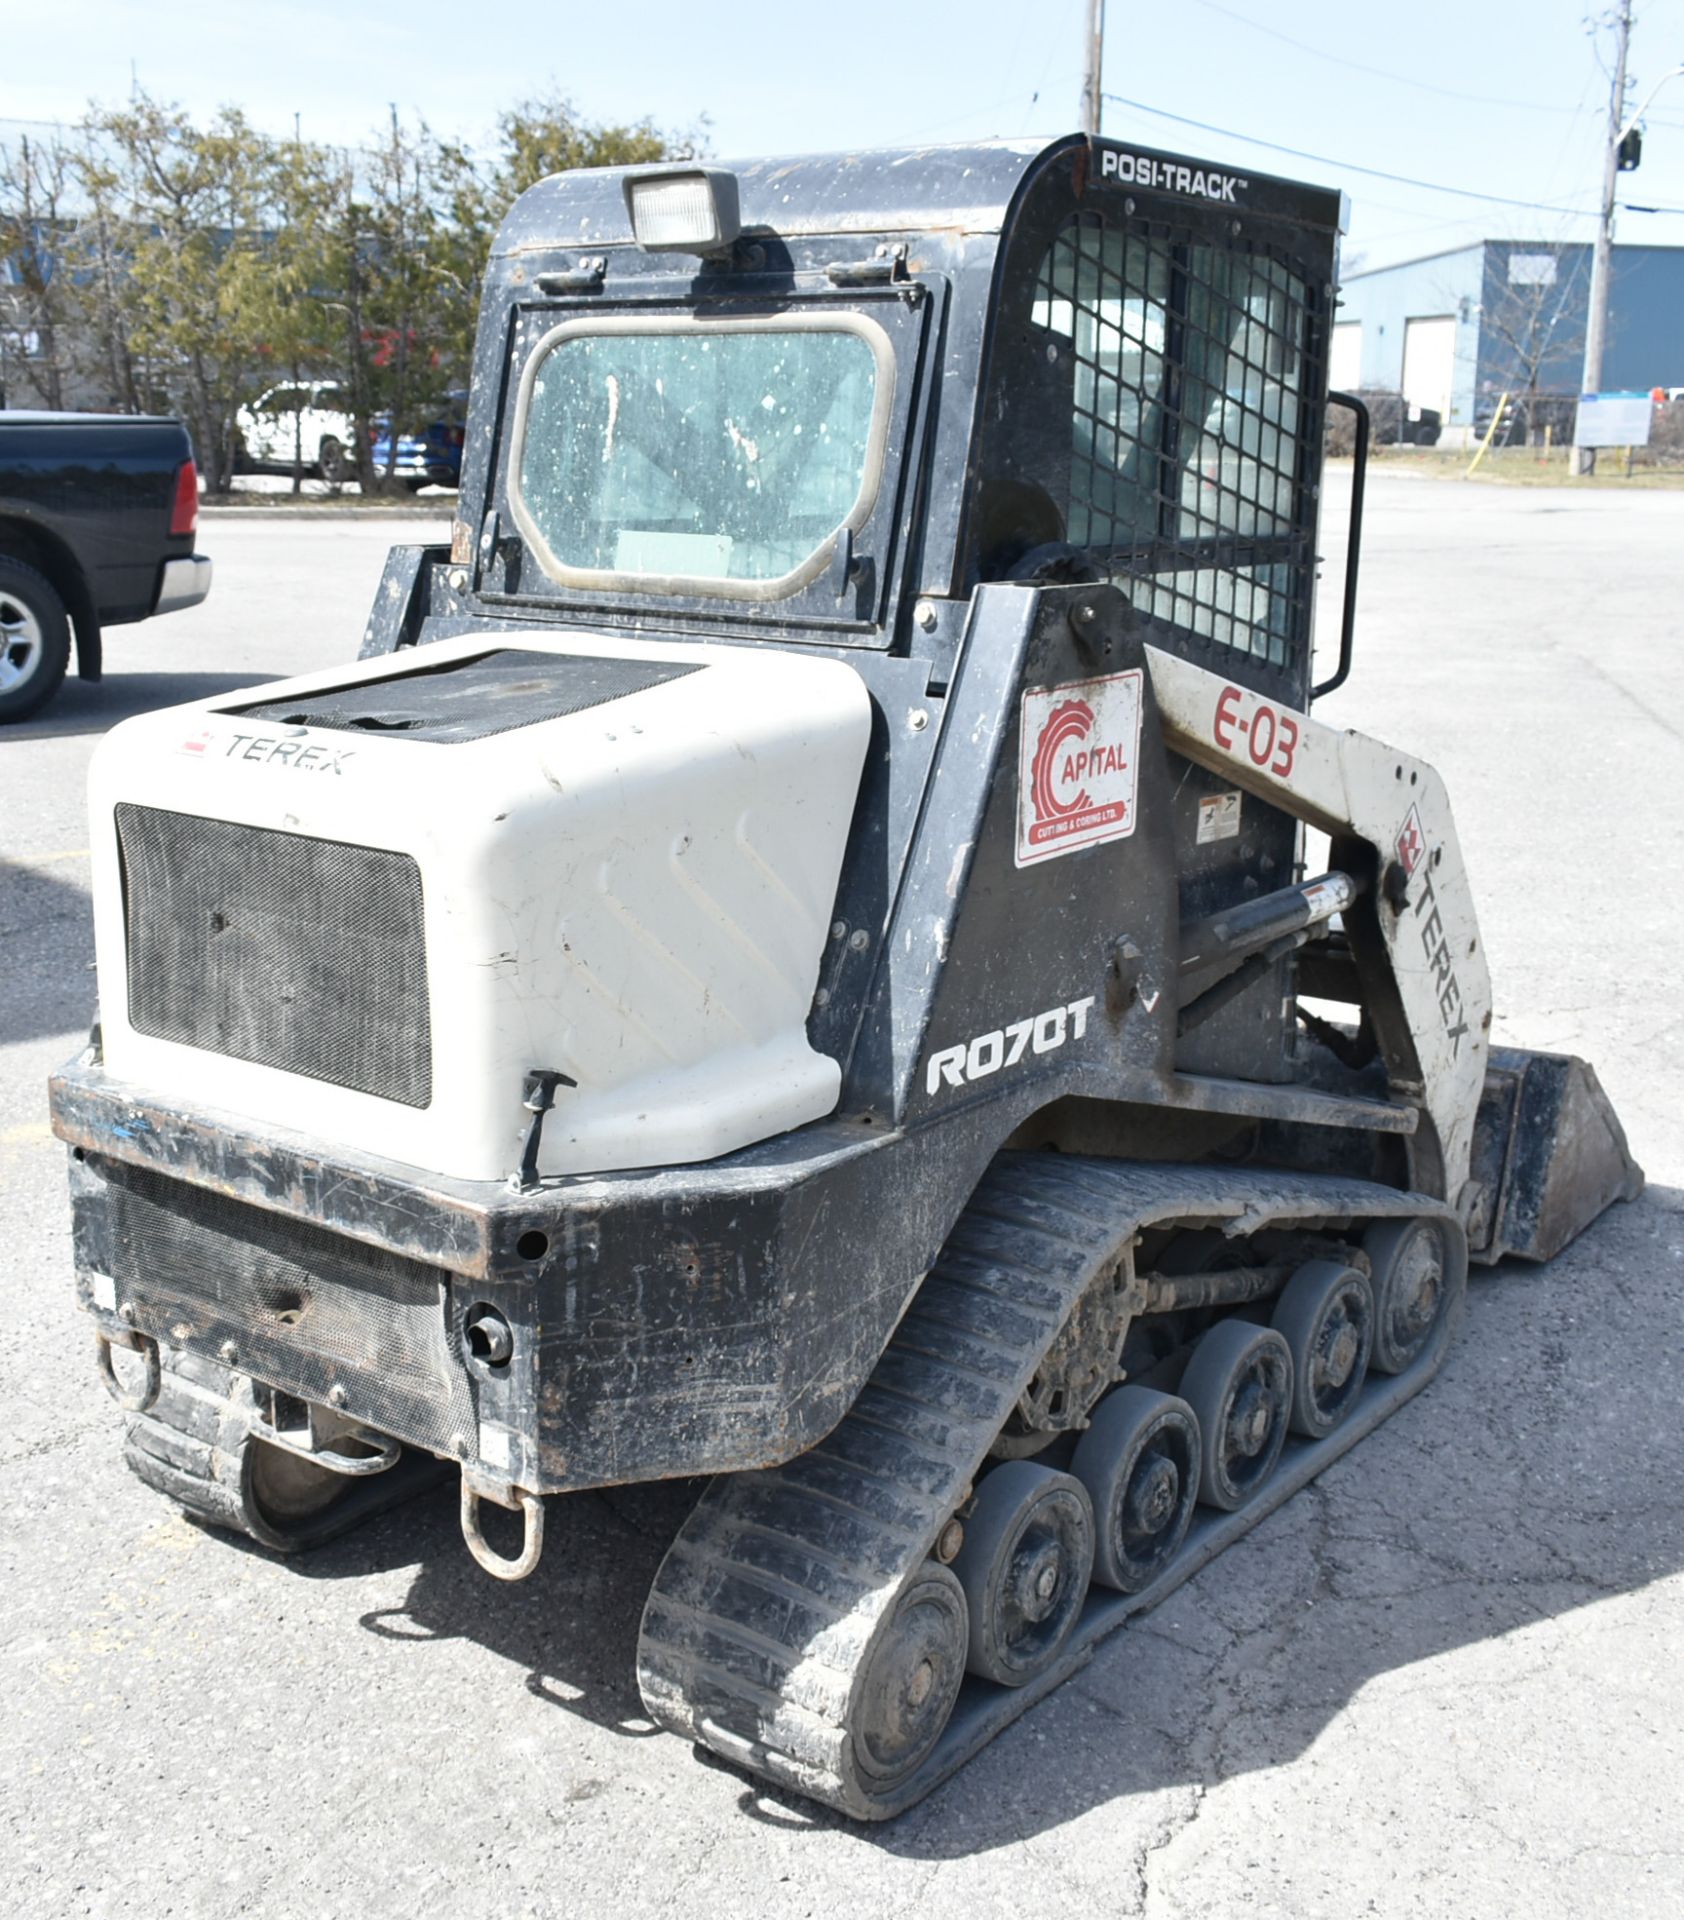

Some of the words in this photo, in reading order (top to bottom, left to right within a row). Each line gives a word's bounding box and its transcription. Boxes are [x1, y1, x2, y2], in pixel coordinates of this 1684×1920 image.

[226, 734, 356, 775] TEREX
[1214, 686, 1298, 778] E-03
[1037, 821, 1068, 839] CUTTING
[1069, 819, 1075, 831] &
[1076, 812, 1102, 827] CORING
[1415, 869, 1469, 1061] TEREX
